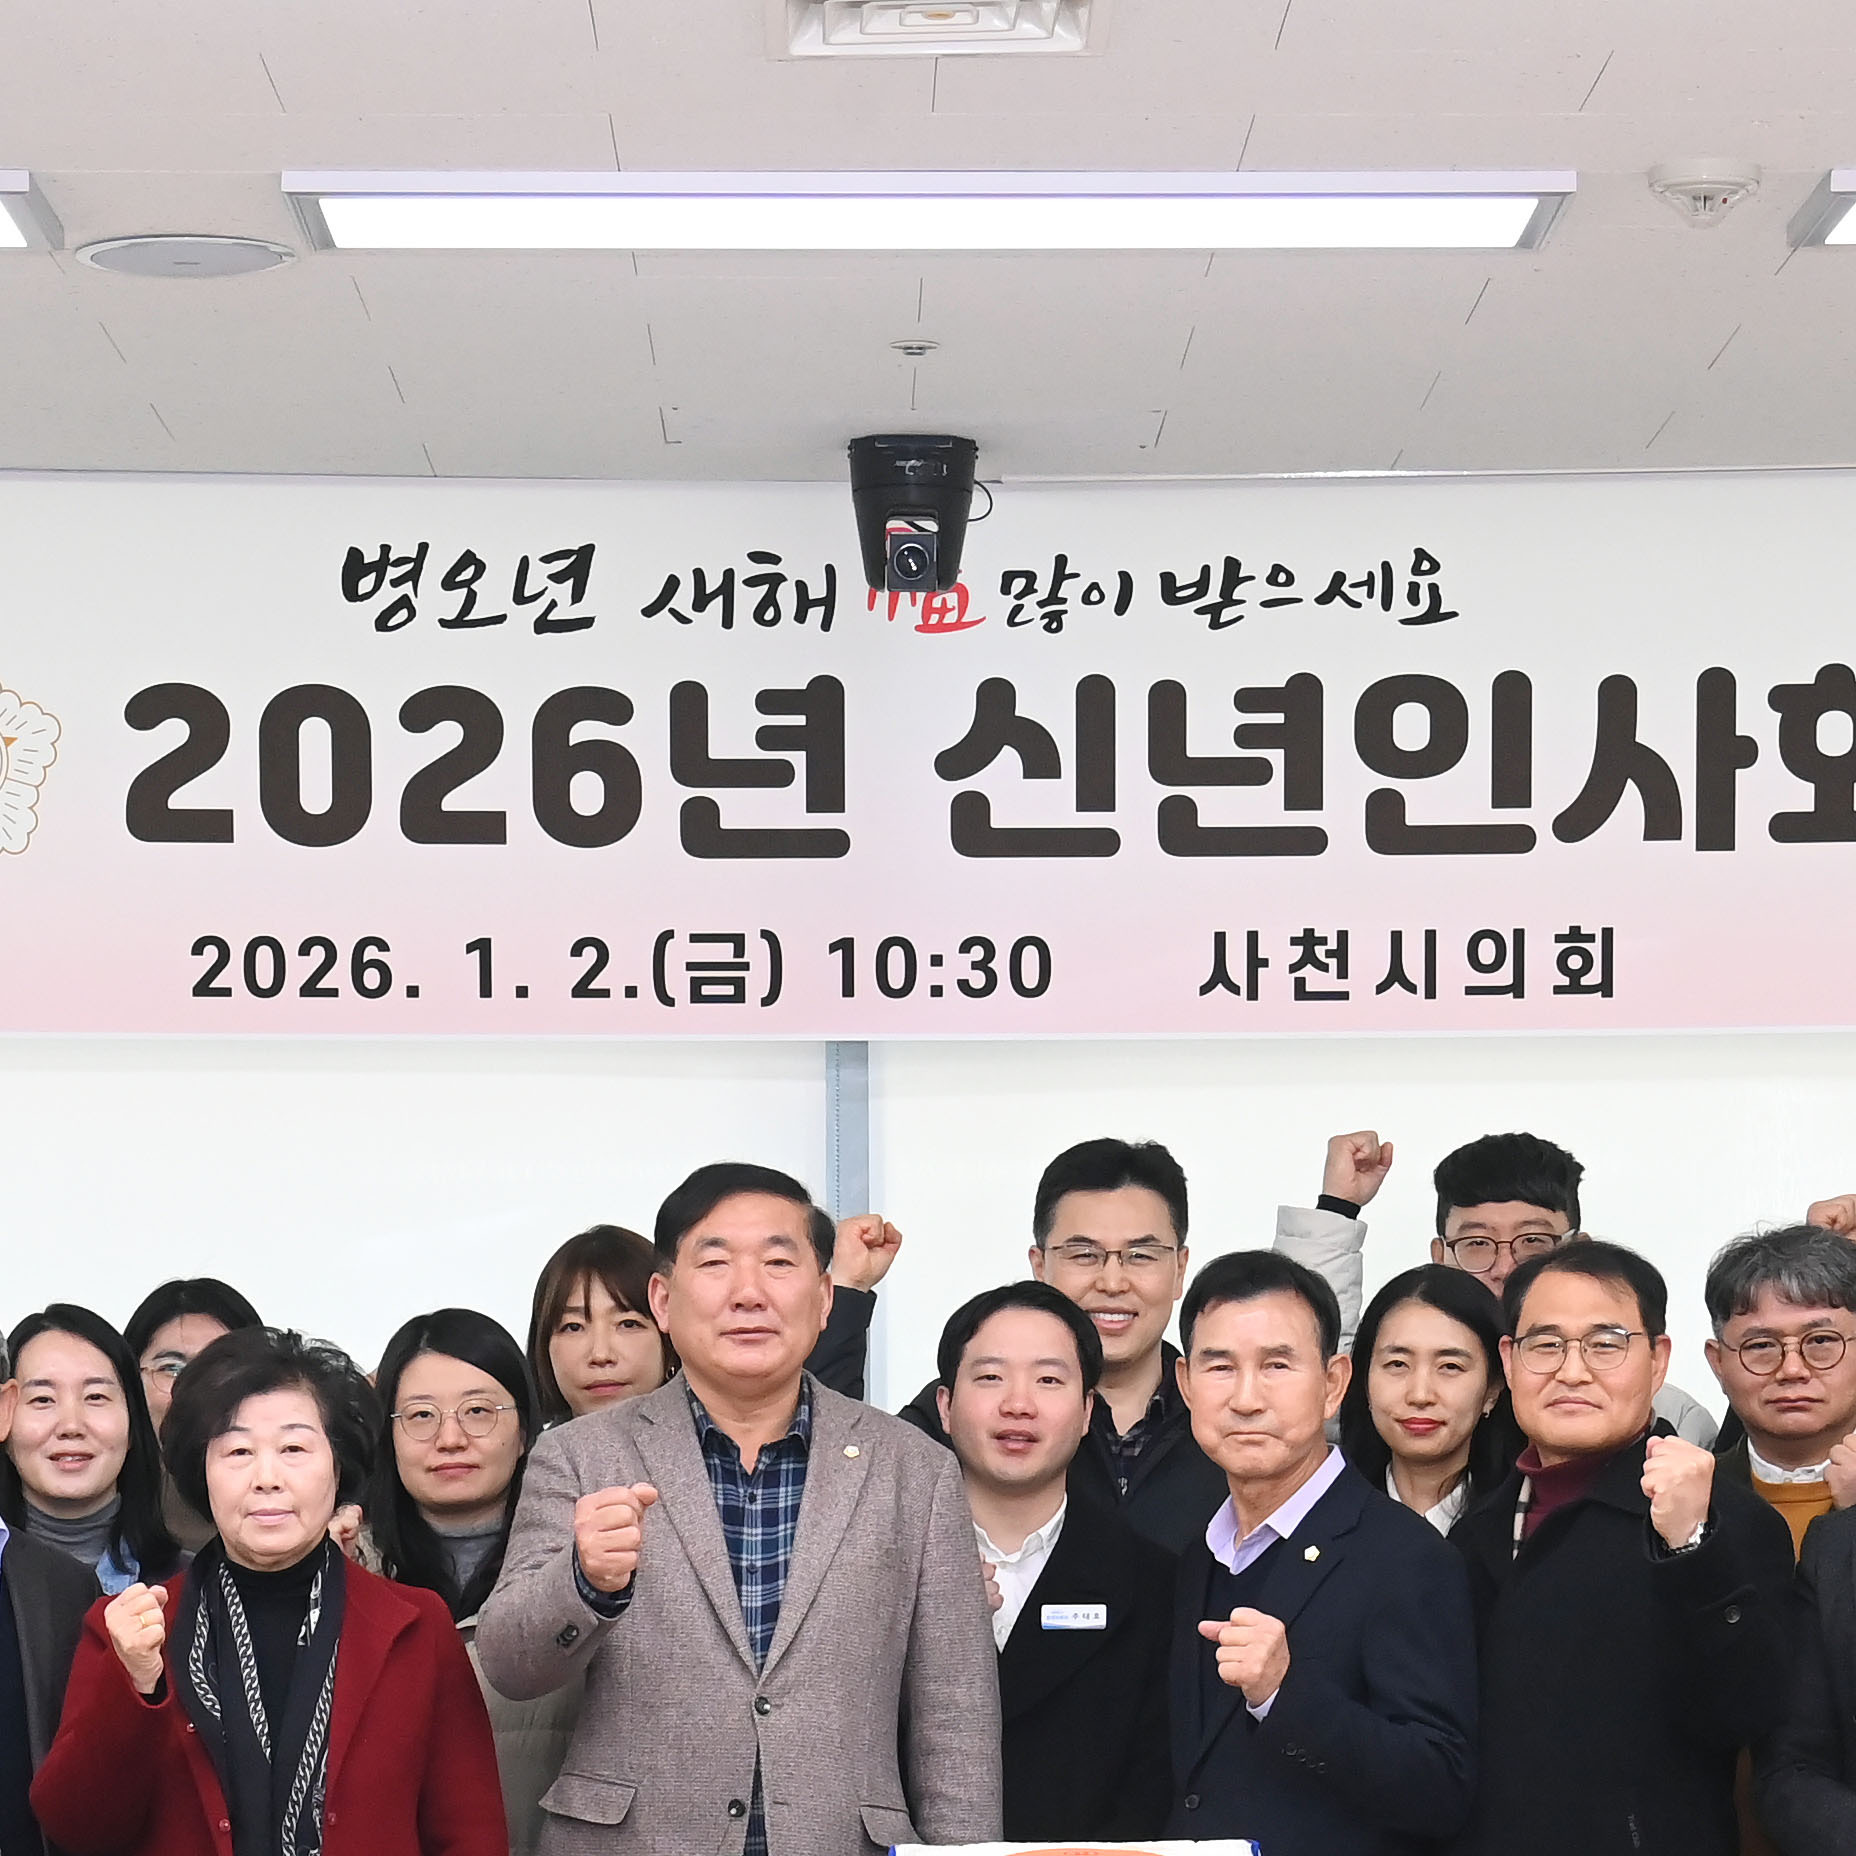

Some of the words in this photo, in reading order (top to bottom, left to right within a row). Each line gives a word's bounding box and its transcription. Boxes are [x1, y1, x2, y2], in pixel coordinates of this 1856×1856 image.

[341, 541, 596, 635] 병오년
[640, 550, 837, 633] 새해
[999, 553, 1134, 634] 많이
[1159, 547, 1460, 631] 받으세요
[124, 674, 851, 859] 2026년
[190, 935, 420, 999] 2026.
[465, 937, 529, 999] 1.
[570, 928, 783, 1008] 2.(금)
[828, 935, 1052, 999] 10:30
[1199, 925, 1614, 1002] 사천시의회
